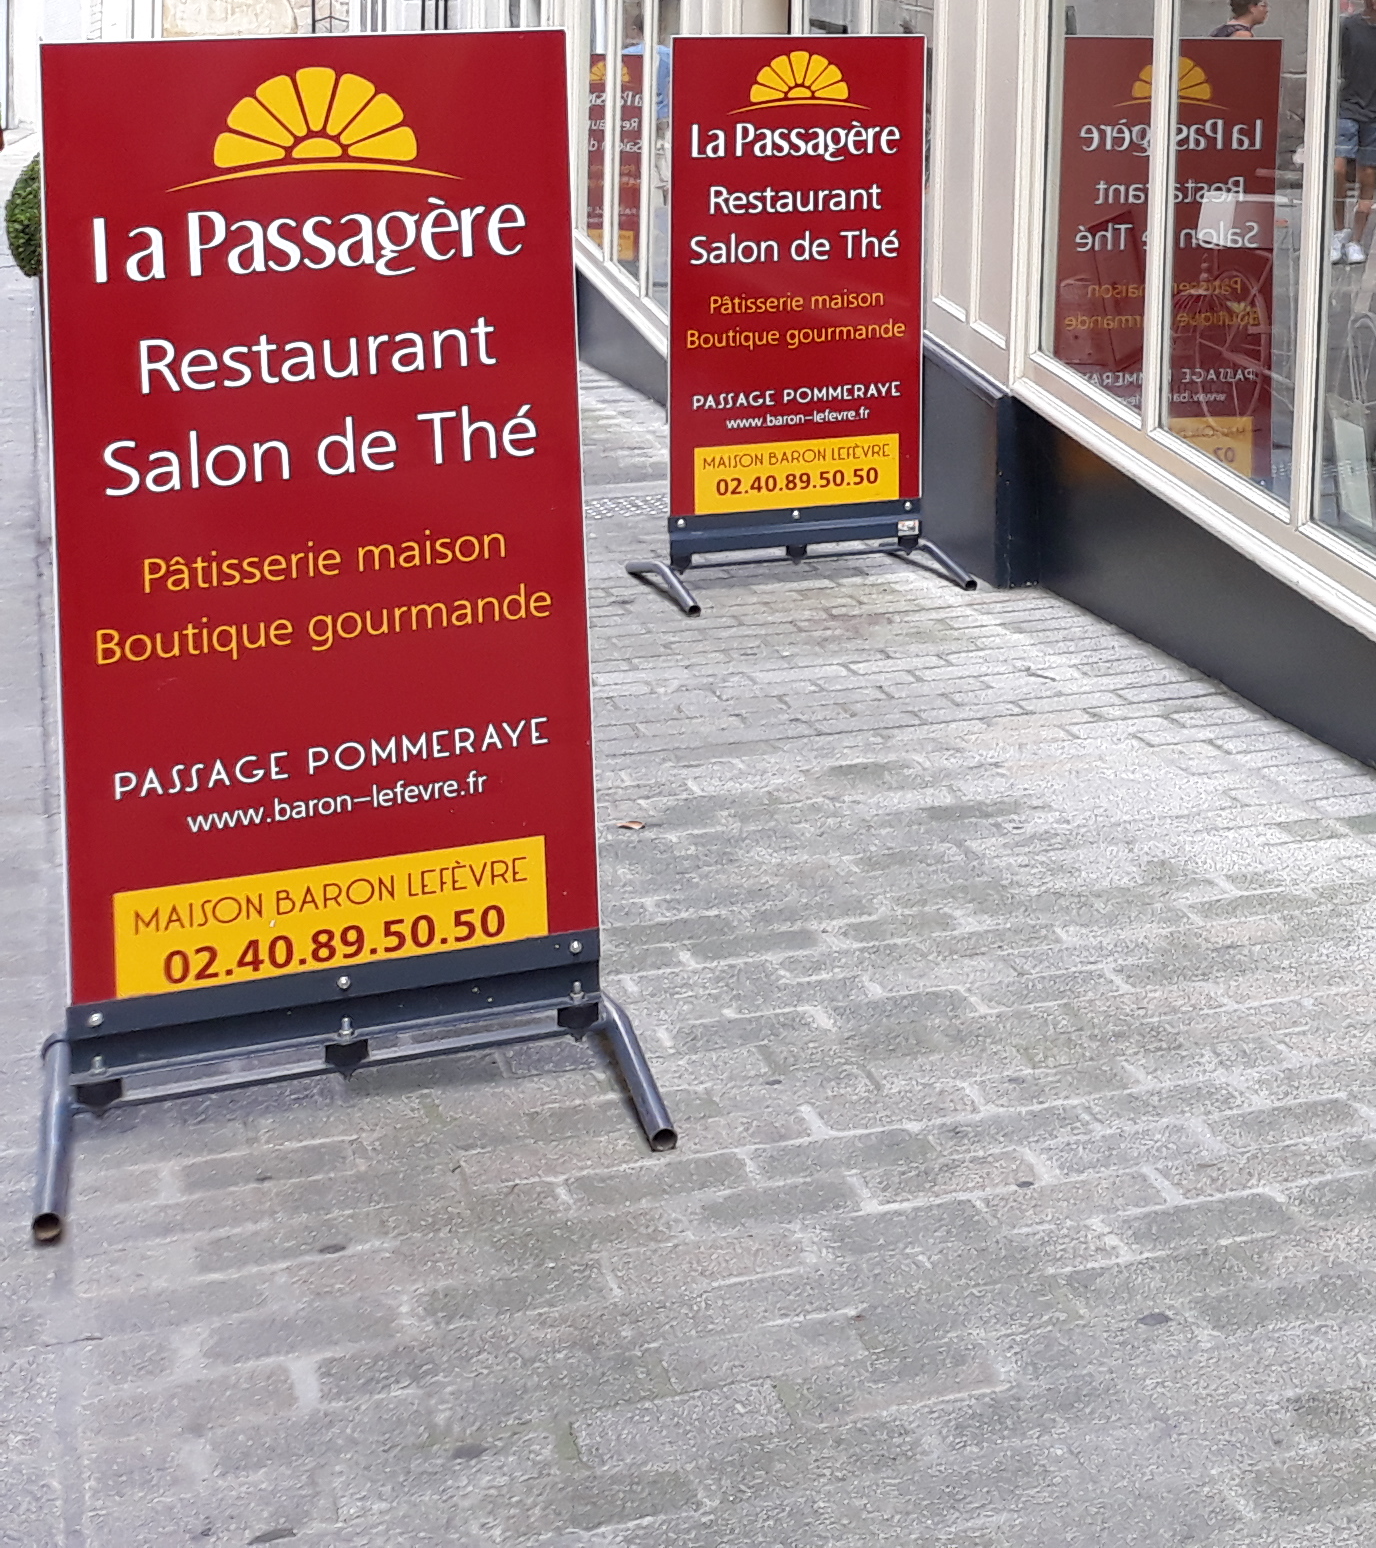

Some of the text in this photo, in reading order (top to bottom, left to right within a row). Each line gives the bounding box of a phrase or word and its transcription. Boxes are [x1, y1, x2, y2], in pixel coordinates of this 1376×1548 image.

[690, 120, 900, 161] La Passagère
[708, 182, 882, 214] Restaurant
[187, 197, 526, 278] Passagère
[689, 228, 900, 266] Salon de Thé
[709, 288, 884, 315] Pâtisserie maison
[138, 316, 497, 395] Restaurant
[685, 319, 905, 352] Boutique gourmande
[692, 381, 901, 410] PASSAGE POMMERAYE
[726, 406, 870, 429] www.baron-lefevre.fr
[103, 404, 538, 498] Salon de Thé
[702, 442, 891, 470] MAISON BARON LEFÈVRE
[715, 466, 879, 496] 02.40.89.50.50
[141, 530, 507, 594] Pâtisserie maison
[95, 583, 553, 666] Boutique gourmande
[114, 717, 549, 800] PASSAGE POMMERAYE
[187, 771, 487, 833] www.baron-lefevre.fr
[133, 856, 528, 936] MAISON BARON LEFÈVRE
[163, 904, 506, 985] 02.40.89.50.50
